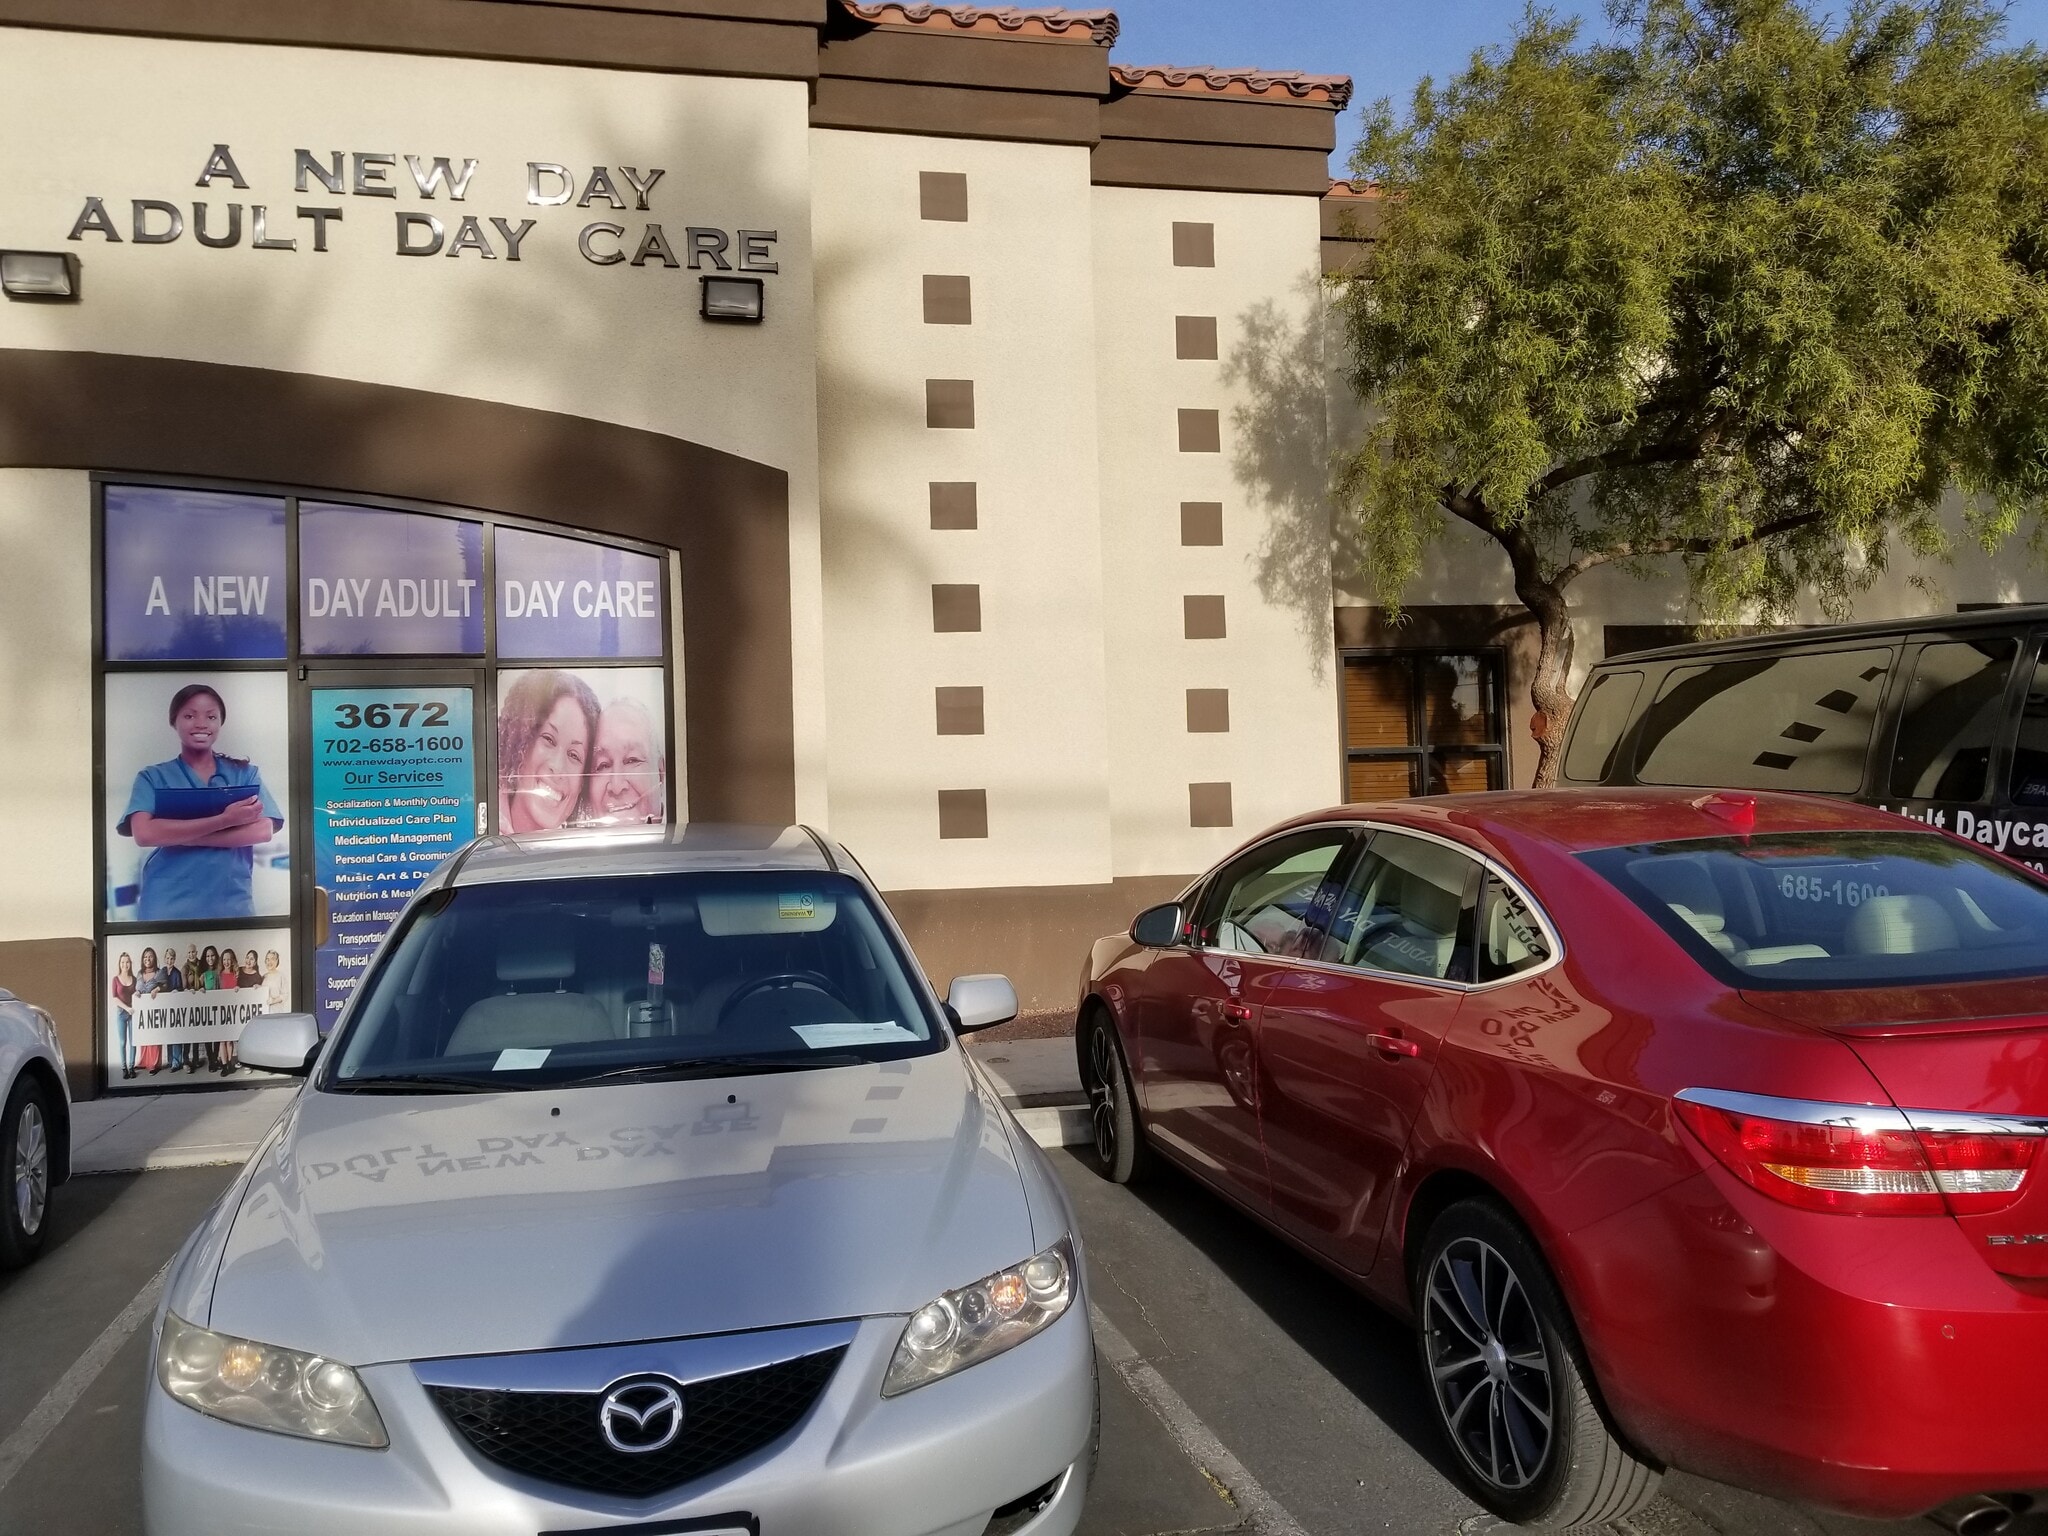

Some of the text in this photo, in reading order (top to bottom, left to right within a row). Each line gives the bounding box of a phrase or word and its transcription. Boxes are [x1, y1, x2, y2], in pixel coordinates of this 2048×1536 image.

[196, 144, 666, 210] A NEW DAY
[67, 196, 779, 275] ADULT DAY CARE
[145, 576, 655, 618] A NEW DAY ADULT DAY CARE
[334, 702, 449, 729] 3672
[323, 736, 464, 754] 702-658-1600
[322, 756, 463, 767] www.anewdayoptc.com
[344, 769, 444, 784] Our Services
[326, 796, 460, 810] Socialization & Monthly Outing
[329, 813, 457, 828] Individualized Care Plan
[334, 831, 453, 846] Medication Management
[335, 853, 375, 865] Personal
[376, 853, 399, 863] Care
[400, 852, 407, 861] &
[335, 873, 374, 883] Music
[376, 872, 397, 881] Art
[399, 871, 409, 880] &
[335, 891, 379, 902] Nutrition
[381, 889, 389, 899] &
[332, 911, 364, 923] Education
[365, 911, 372, 921] in
[337, 954, 368, 969] Physical
[325, 999, 344, 1011] Large
[138, 1009, 145, 1030] A
[147, 1008, 168, 1029] NEW
[169, 1007, 187, 1028] DAY
[188, 1006, 218, 1027] ADULT
[220, 1004, 238, 1026] DAY
